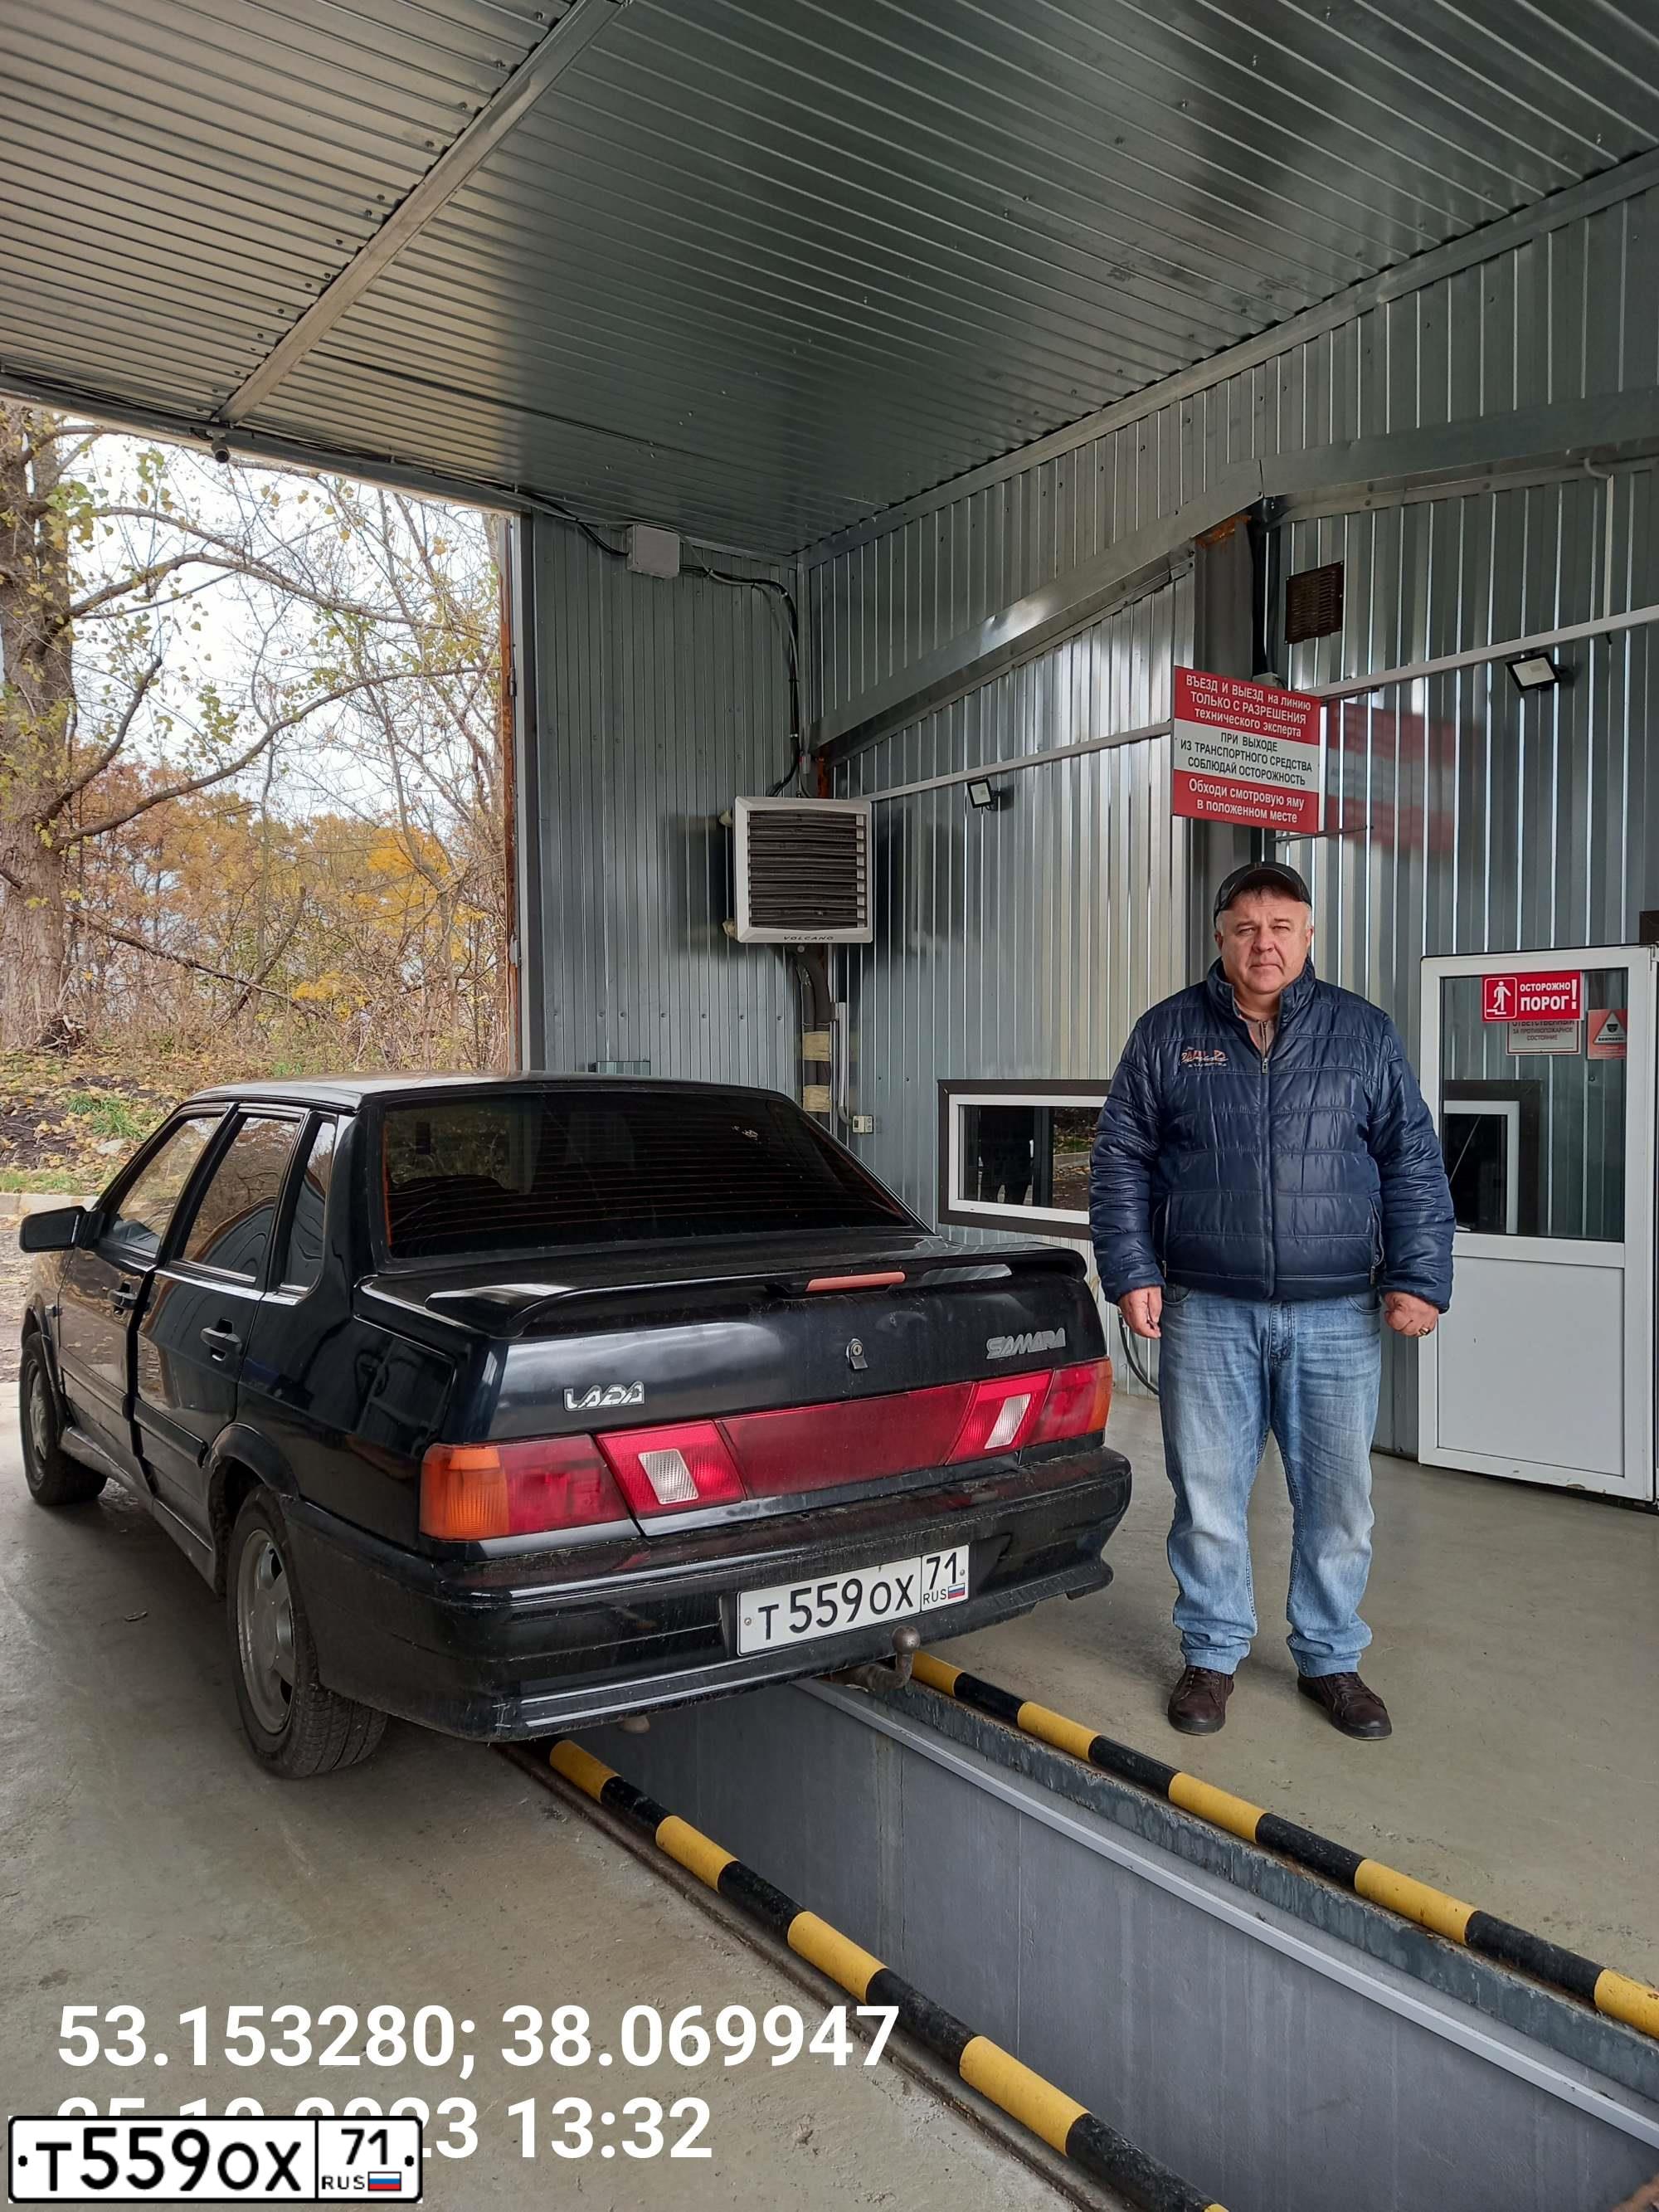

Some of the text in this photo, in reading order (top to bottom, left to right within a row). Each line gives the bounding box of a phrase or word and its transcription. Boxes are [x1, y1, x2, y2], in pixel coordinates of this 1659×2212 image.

[1186, 675, 1311, 711] ВЪЕЗД И ВЫЕЗД на линию
[1190, 691, 1306, 724] ТОЛЬКО С РАЗРЕШЕНИЯ
[1194, 708, 1301, 738] технического эксперта
[1180, 739, 1312, 772] ИЗ ТРАНСПОРТНОГО СРЕДСТВА
[1221, 733, 1278, 752] ПРИ ВЫХОДЕ
[1188, 756, 1306, 786] СОБЛЮДАЙ ОСТОРОЖНОСТЬ
[1189, 778, 1305, 811] Обходи смотровую яму
[1206, 800, 1267, 819] положенном
[1270, 811, 1297, 823] месте
[1520, 982, 1571, 992] ОСТОРОЖНО
[986, 1328, 1066, 1359] SAMARA
[564, 1381, 645, 1411] LADA
[926, 1552, 956, 1591] 71
[923, 1588, 947, 1605] RUS
